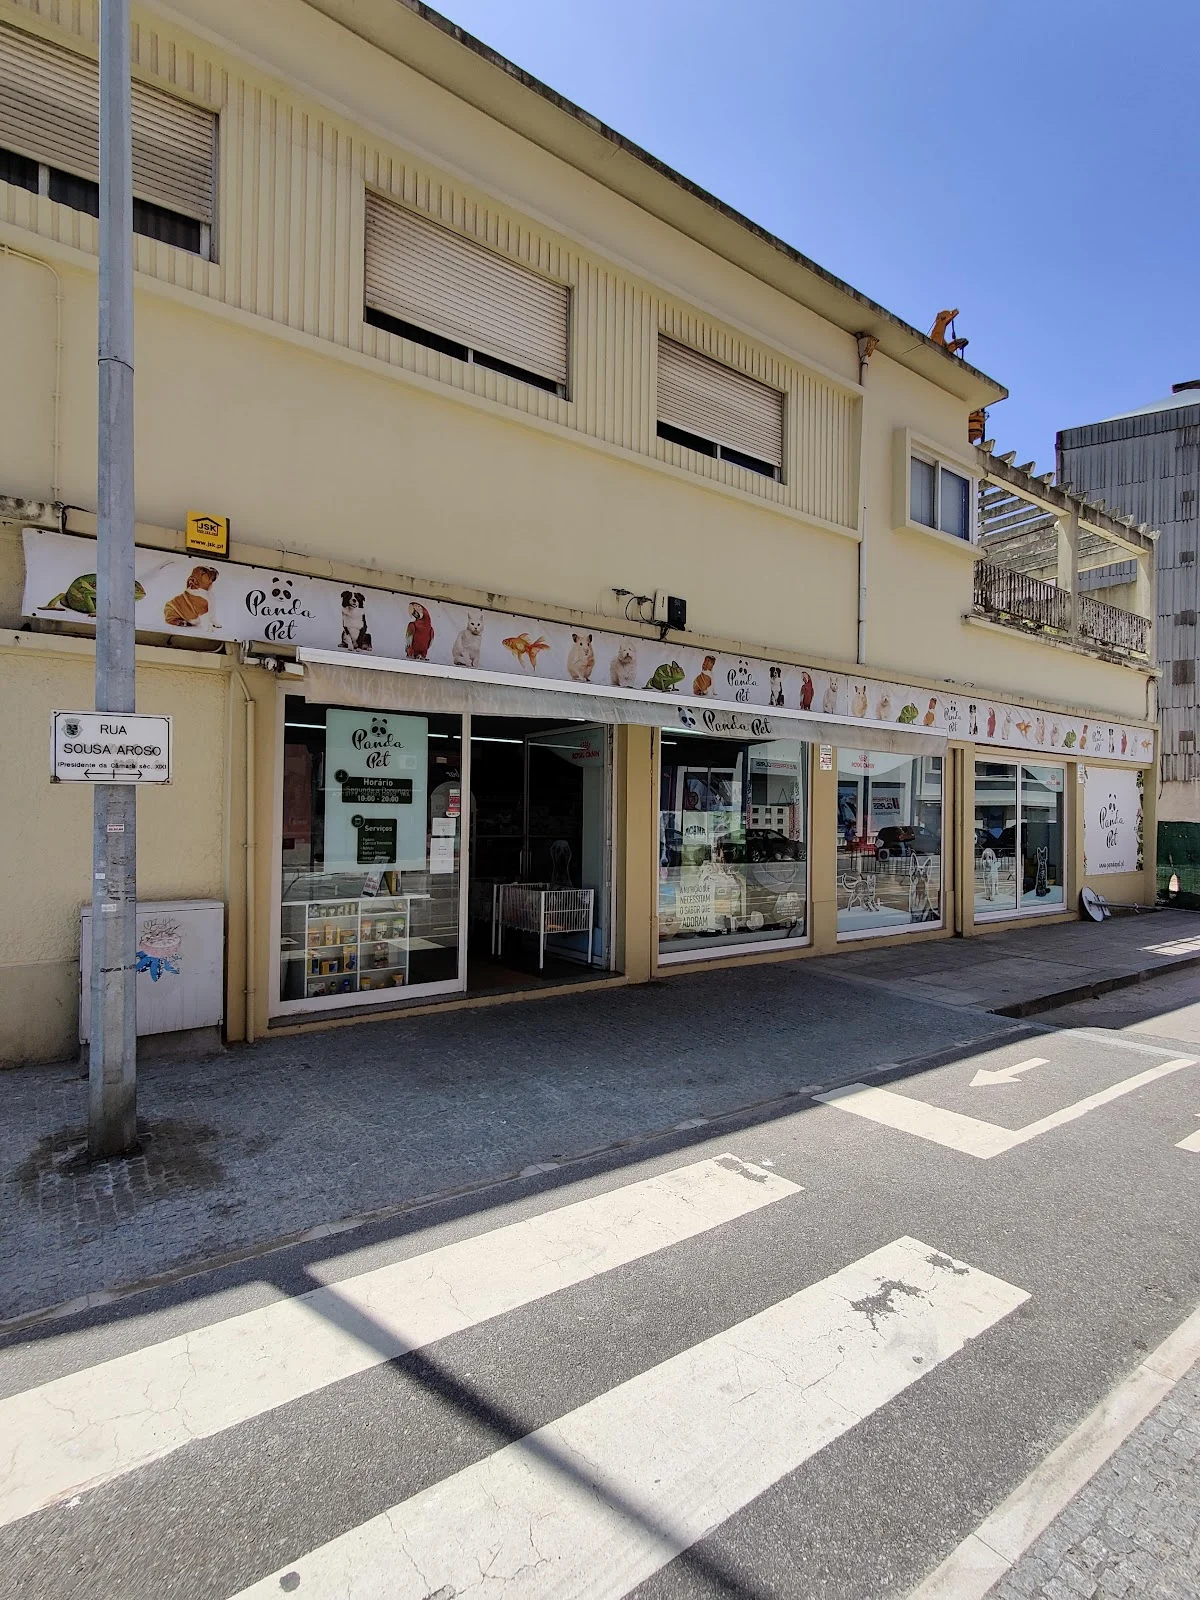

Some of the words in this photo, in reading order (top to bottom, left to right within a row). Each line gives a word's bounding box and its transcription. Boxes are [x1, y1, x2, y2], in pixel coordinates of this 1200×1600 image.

[199, 522, 217, 532] JSK
[245, 589, 316, 619] Panda
[264, 619, 298, 641] Pet
[727, 668, 759, 687] Panda
[735, 687, 750, 703] Pet
[100, 724, 128, 736] RUA
[703, 709, 749, 732] Panda
[751, 717, 772, 737] Pet
[351, 728, 406, 751] Panda
[63, 743, 112, 755] SOUSA
[116, 745, 162, 757] AROSO
[366, 750, 392, 769] Pet
[363, 777, 394, 787] Horário
[1099, 806, 1125, 830] Panda
[364, 824, 393, 833] Serviços
[1106, 827, 1119, 849] Pet
[679, 894, 711, 905] NECESSITAM
[684, 904, 701, 915] SABOR
[701, 904, 711, 913] QUE
[682, 915, 708, 928] ADORAM
